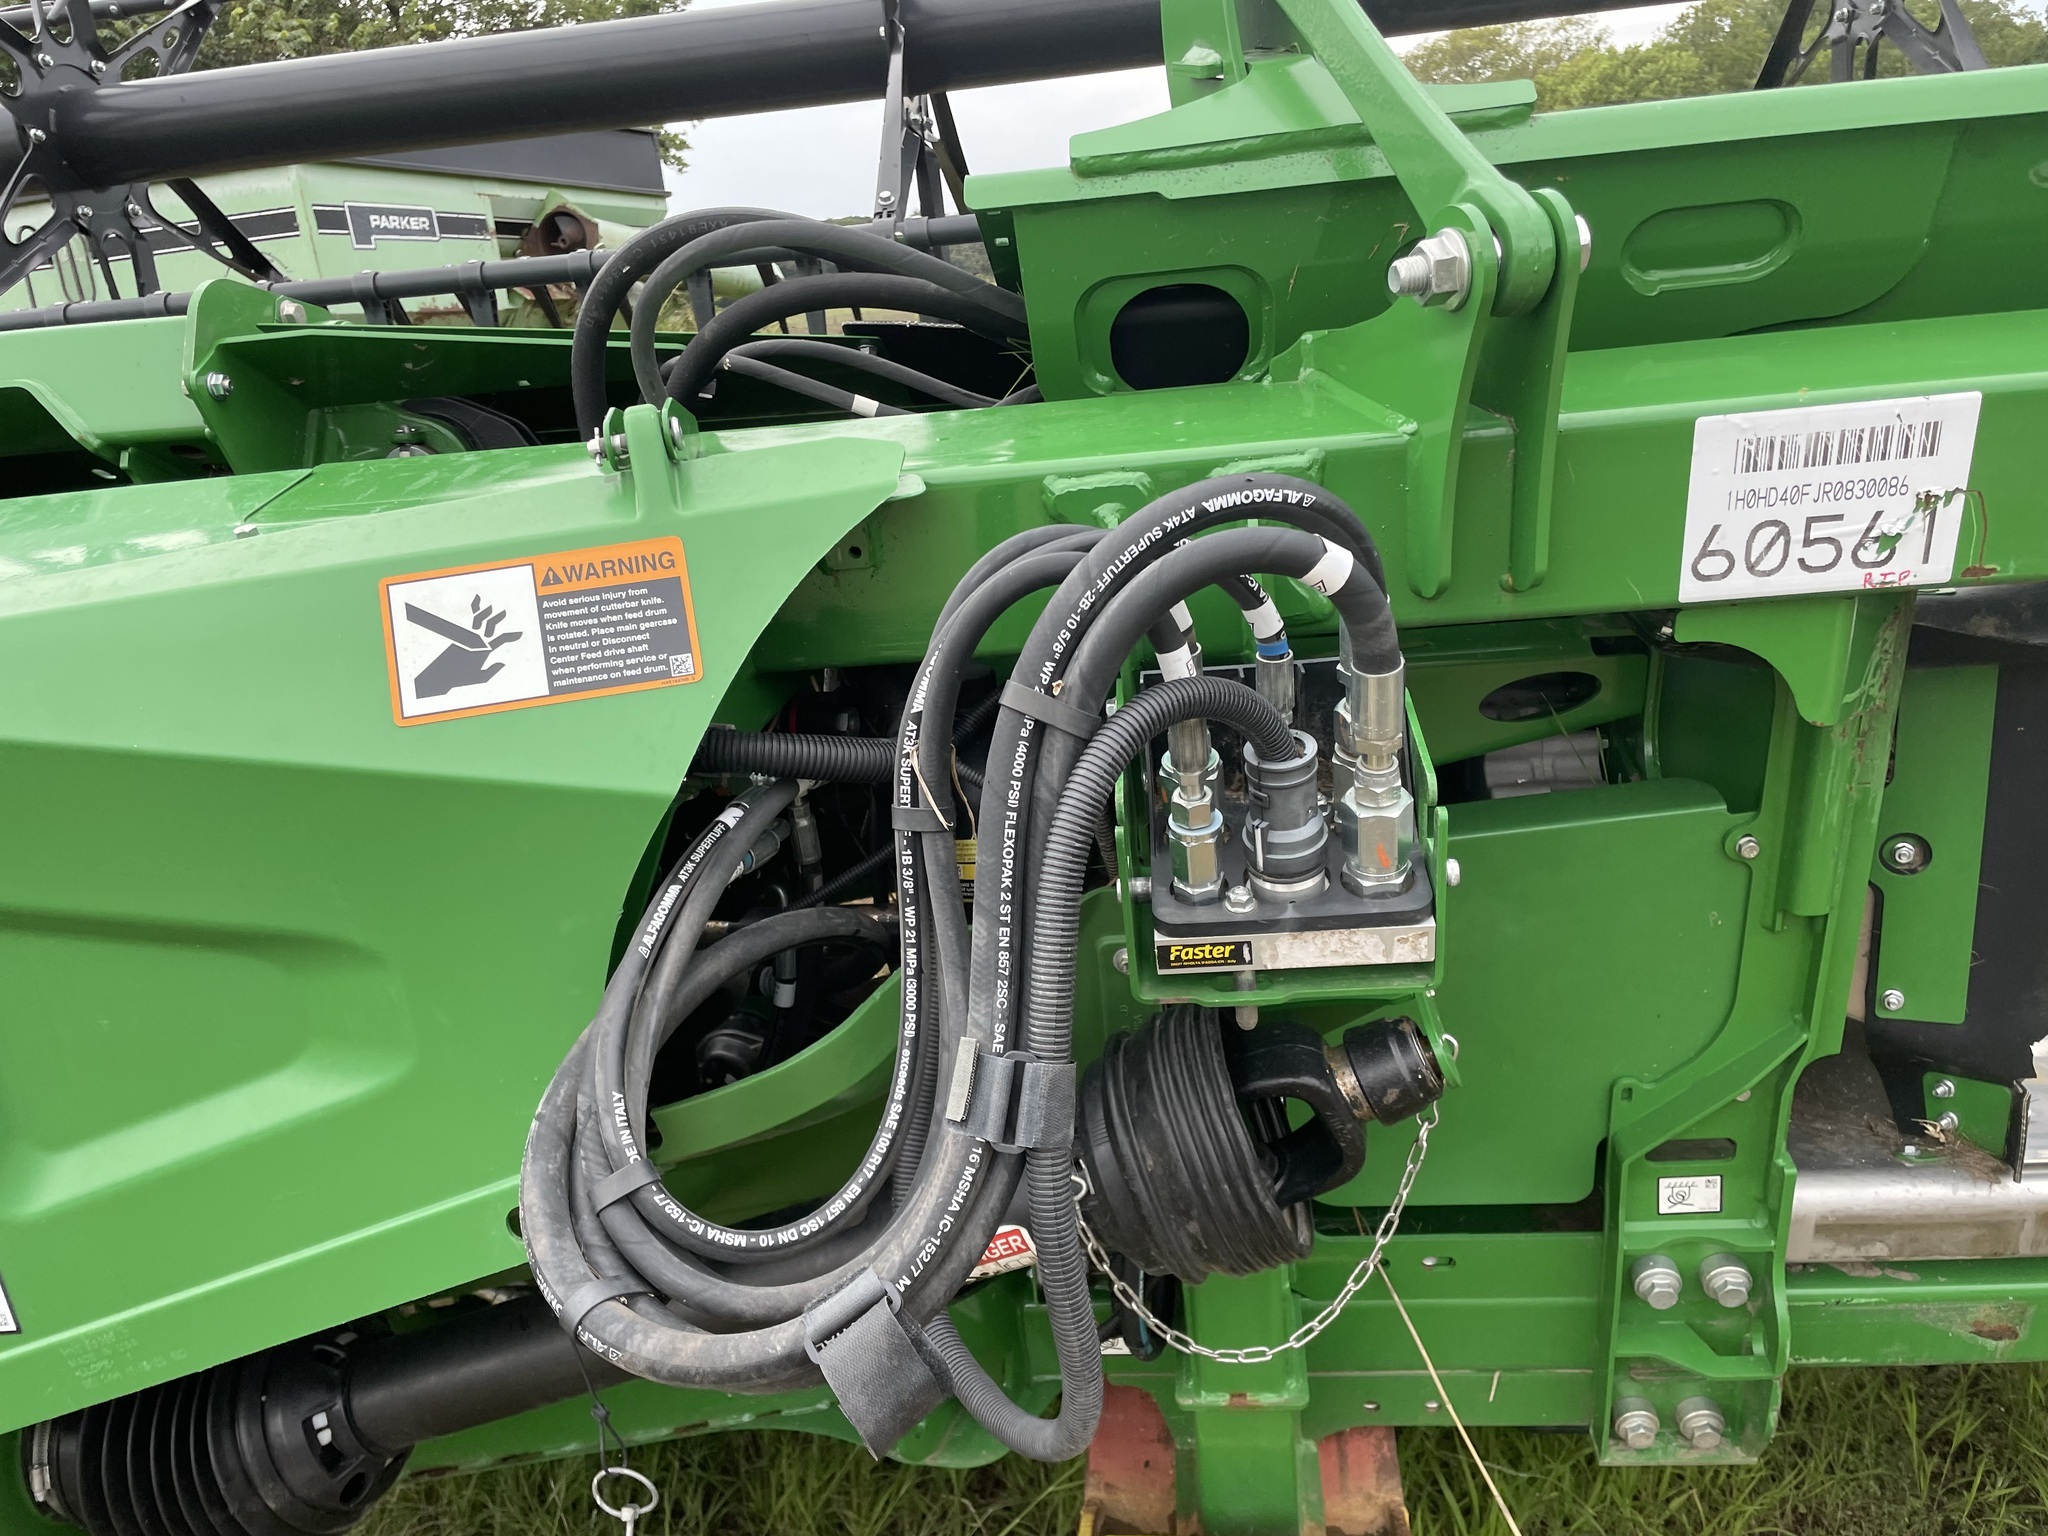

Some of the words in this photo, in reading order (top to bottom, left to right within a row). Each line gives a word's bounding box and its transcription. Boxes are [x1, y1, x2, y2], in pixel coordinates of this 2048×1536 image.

[369, 214, 430, 231] PARKER
[1201, 488, 1302, 513] ALFAGOMMA
[1162, 505, 1196, 533] AT4K
[1691, 509, 1938, 582] 60561
[562, 551, 676, 583] WARNING
[1066, 526, 1163, 630] SUPERTUFF-2B-10
[542, 599, 567, 609] Avoid
[569, 593, 600, 605] serious
[602, 589, 626, 601] injury
[628, 588, 648, 597] from
[544, 607, 589, 620] movement
[590, 605, 599, 613] of
[601, 599, 639, 612] cutterbar
[641, 596, 665, 606] knife.
[545, 621, 569, 631] Knife
[570, 617, 599, 628] moves
[600, 613, 623, 623] when
[624, 610, 644, 620] feed
[645, 607, 668, 617] drum
[547, 634, 555, 642] is
[557, 629, 590, 641] rotated.
[591, 626, 615, 636] Place
[616, 623, 638, 632] main
[639, 617, 678, 631] gearcase
[549, 645, 557, 653] in
[559, 640, 589, 652] neutral
[591, 639, 601, 647] or
[602, 632, 650, 646] Disconnect
[550, 653, 579, 665] Center
[580, 650, 602, 661] Feed
[603, 646, 625, 657] drive
[627, 643, 649, 654] shaft
[1052, 629, 1072, 660] 5/8"
[551, 666, 575, 676] when
[577, 658, 624, 674] performing
[625, 654, 657, 665] service
[658, 653, 668, 662] or
[553, 673, 609, 688] maintenance
[610, 670, 621, 679] on
[623, 667, 642, 678] feed
[643, 664, 669, 675] drum.
[1038, 660, 1056, 685] WP
[1012, 740, 1029, 778] (4000
[1007, 780, 1022, 808] PSI)
[901, 848, 913, 865] 1B
[1000, 811, 1018, 889] FLEXOPAK
[642, 884, 683, 950] ALFAGOMMA
[677, 860, 697, 883] AT3K
[690, 822, 727, 863] SUPERTUFF
[902, 867, 915, 894] 3/8"
[1000, 892, 1012, 901] 2
[904, 906, 916, 928] WP
[999, 904, 1011, 924] ST
[905, 930, 916, 944] 21
[998, 927, 1011, 947] EN
[905, 948, 917, 976] MPa
[998, 951, 1010, 976] 857
[1170, 944, 1235, 961] Faster
[905, 978, 917, 1011] (3000
[996, 979, 1009, 1009] 2SC
[903, 1013, 916, 1038] PSI)
[992, 1023, 1006, 1053] SAE
[895, 1048, 911, 1101] exceeds
[612, 1090, 629, 1128] ITALY
[884, 1102, 903, 1131] SAE
[619, 1130, 634, 1145] IN
[875, 1132, 892, 1154] 100
[863, 1155, 883, 1179] R17
[968, 1147, 983, 1163] 16
[842, 1183, 862, 1204] EN
[947, 1165, 976, 1212] MSHA
[654, 1193, 705, 1235] IC-152/7
[825, 1201, 846, 1221] 857
[707, 1227, 747, 1247] MSHA
[778, 1232, 799, 1244] DN
[801, 1214, 825, 1237] 1SC
[759, 1237, 775, 1247] 10
[910, 1213, 955, 1278] IC-152/7
[981, 1235, 1027, 1261] GER
